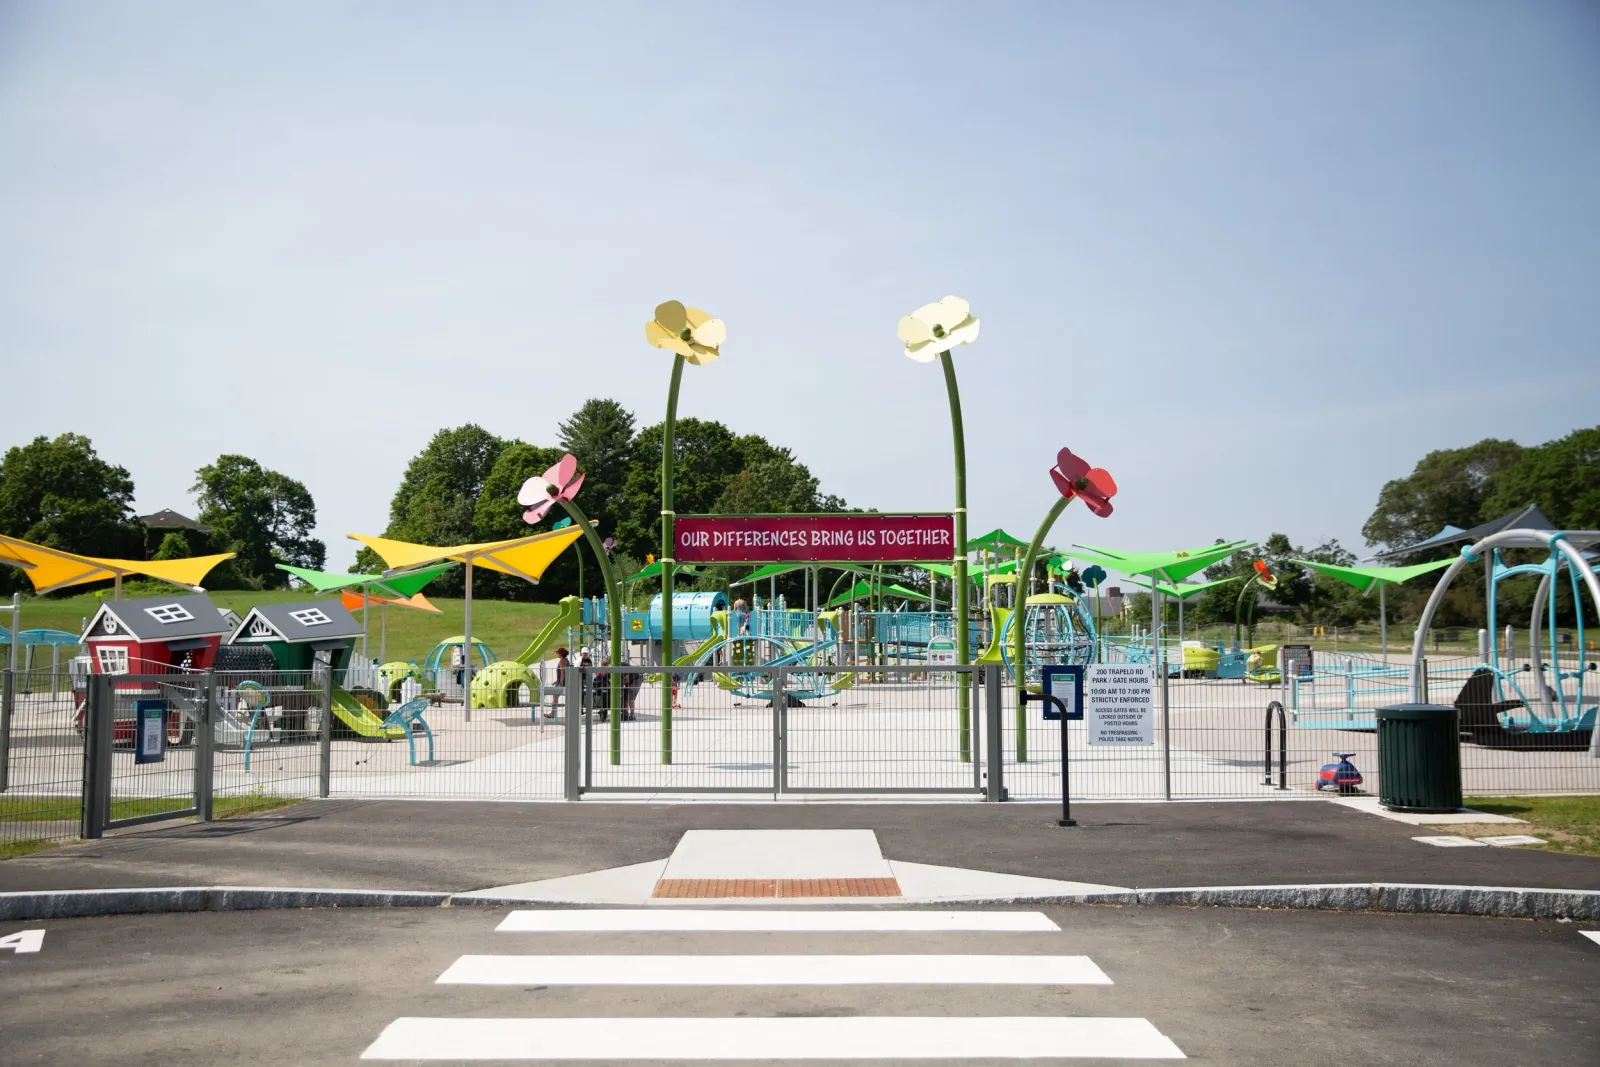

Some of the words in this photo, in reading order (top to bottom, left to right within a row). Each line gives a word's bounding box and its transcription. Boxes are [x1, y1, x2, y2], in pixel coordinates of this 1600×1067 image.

[681, 531, 710, 546] OUR
[713, 530, 808, 546] DIFFERENCES
[811, 530, 854, 546] BRING
[858, 530, 876, 546] US
[880, 529, 950, 546] TOGETHER
